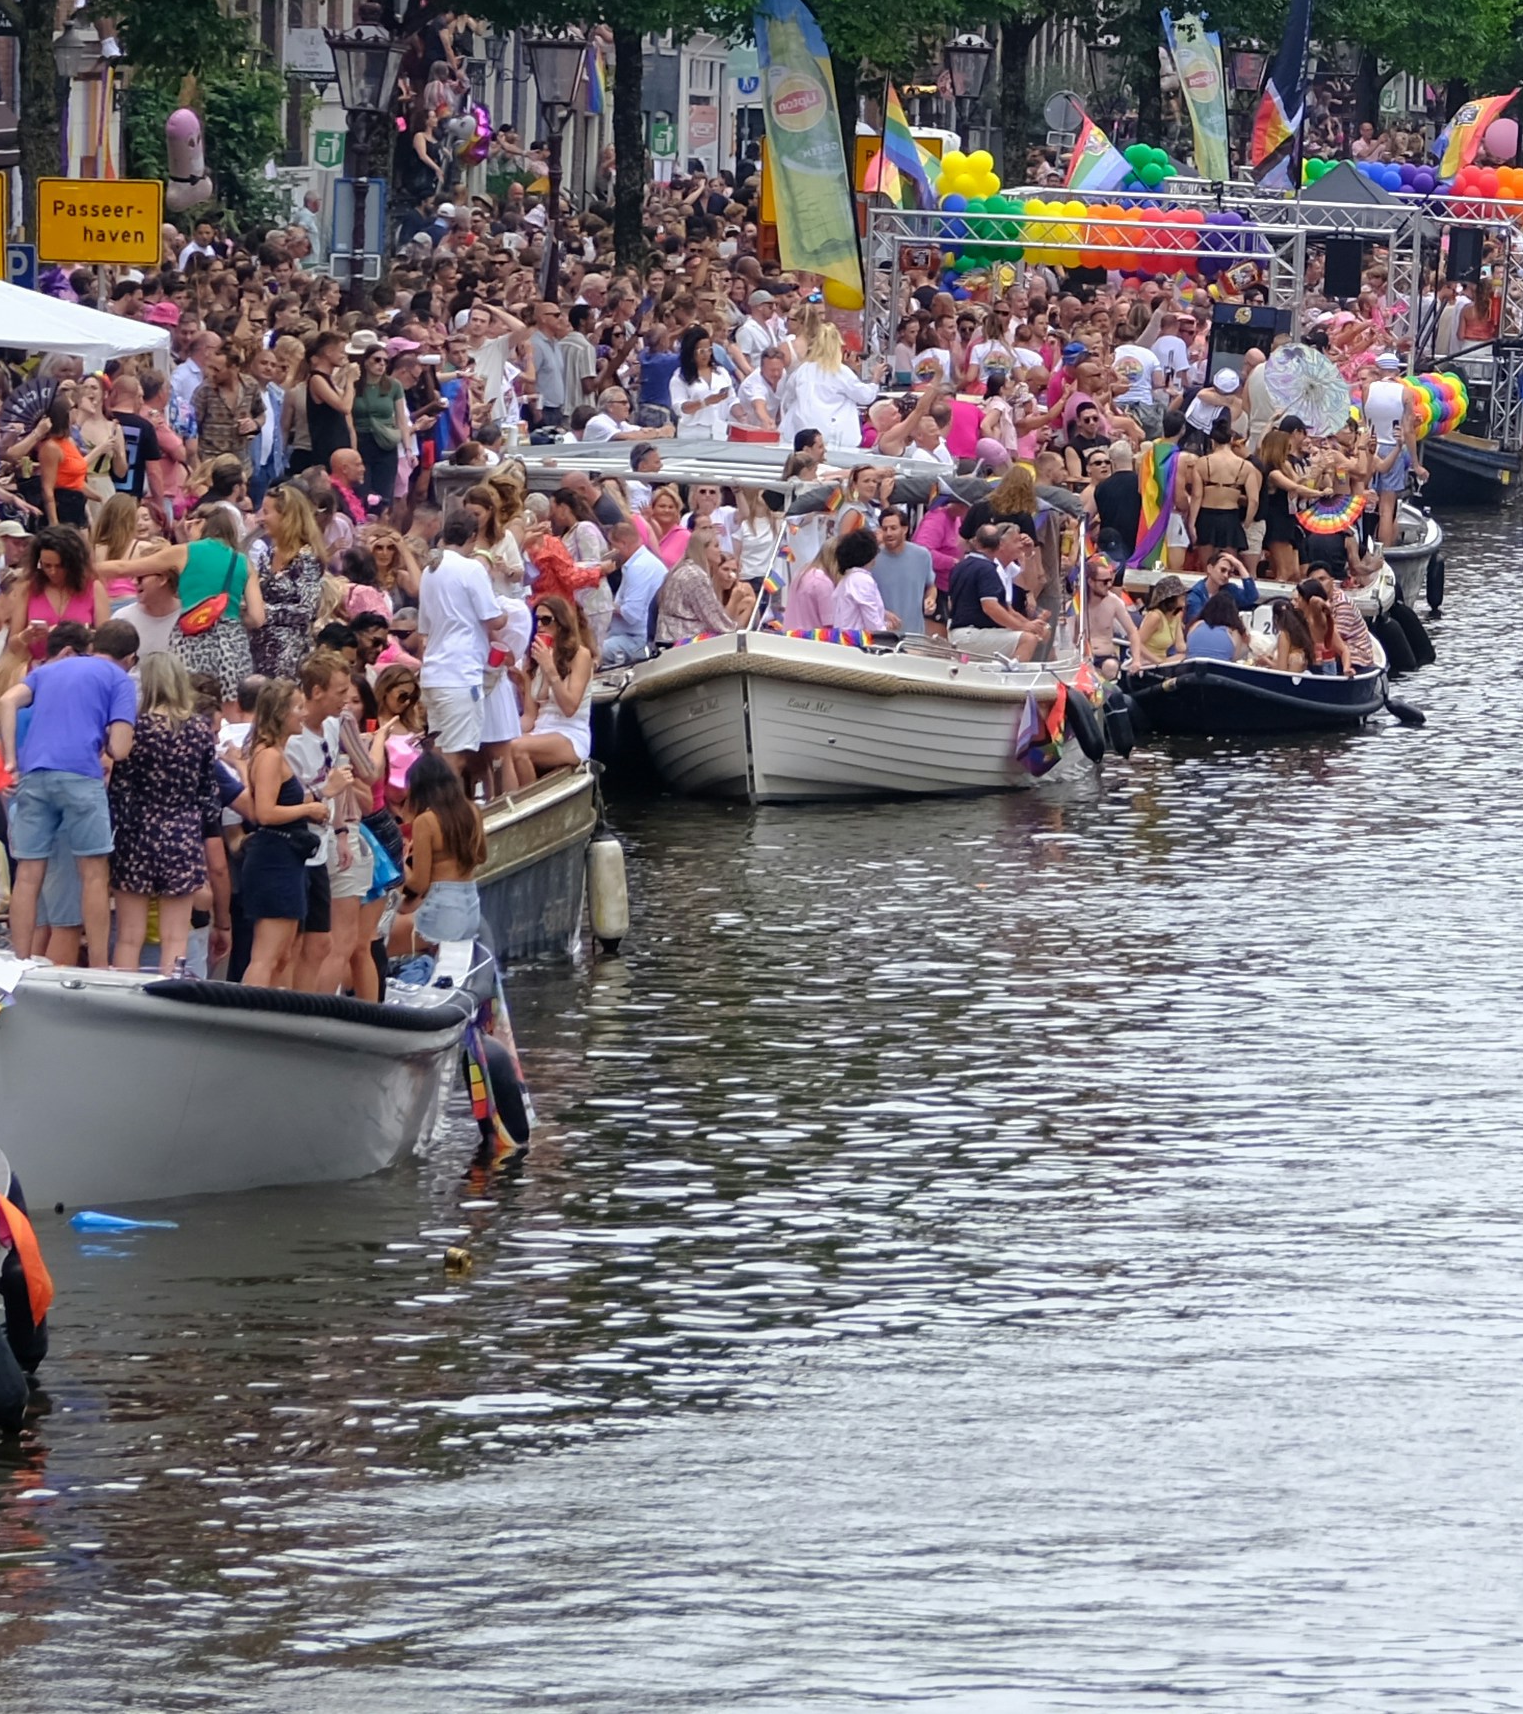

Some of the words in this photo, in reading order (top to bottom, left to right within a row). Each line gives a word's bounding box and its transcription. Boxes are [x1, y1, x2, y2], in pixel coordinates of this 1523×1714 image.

[53, 200, 143, 217] Passeer-
[83, 227, 145, 244] haven
[9, 250, 29, 277] P
